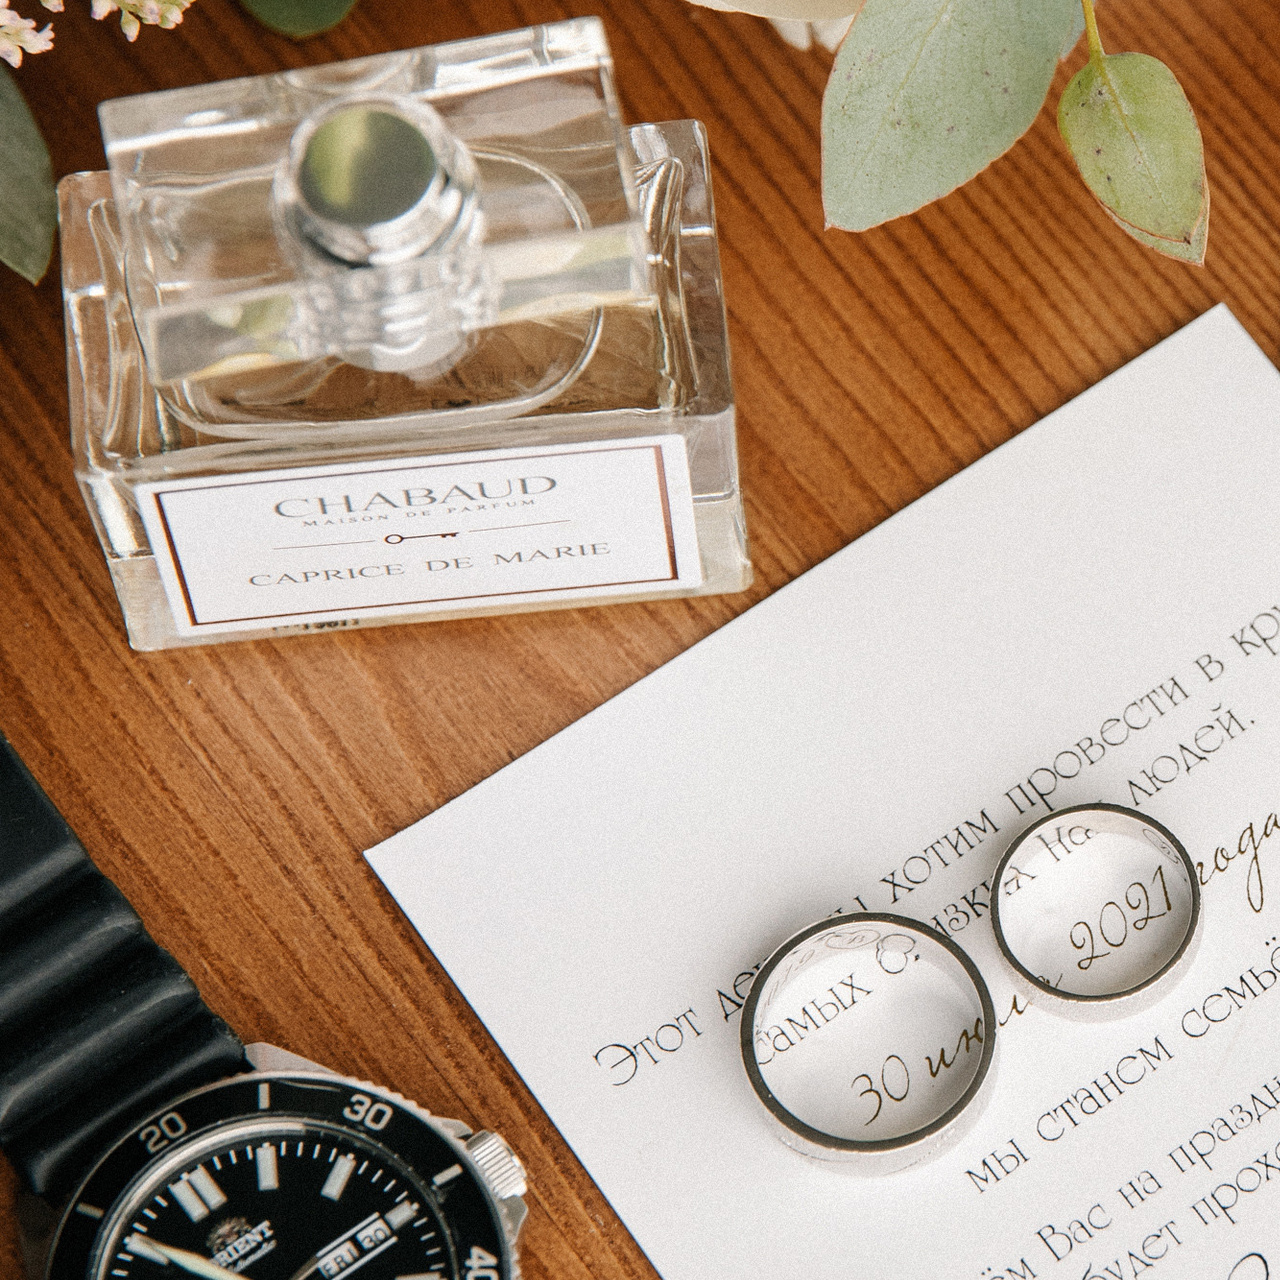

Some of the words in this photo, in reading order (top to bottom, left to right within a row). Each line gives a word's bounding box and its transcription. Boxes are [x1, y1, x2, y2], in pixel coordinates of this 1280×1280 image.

[274, 475, 558, 519] CHABAUD
[302, 513, 390, 528] MAISON
[405, 509, 431, 519] DE
[249, 563, 406, 588] CAPRICE
[427, 556, 475, 573] DE
[494, 542, 613, 566] MARIE
[1126, 702, 1256, 807] людей.
[593, 1007, 704, 1087] Этот
[879, 807, 1001, 905] хотим
[1003, 676, 1191, 814] провести
[1193, 653, 1226, 683] в
[850, 1054, 911, 1127] 30
[1069, 864, 1172, 970] 2021
[138, 1111, 188, 1154] 20
[342, 1093, 394, 1132] 30
[964, 1138, 1031, 1194] мы
[1035, 1034, 1175, 1143] станем
[1035, 1202, 1114, 1262] Вас
[1115, 1169, 1164, 1210] на
[212, 1220, 275, 1268] RIENT
[322, 1244, 359, 1278] FRI
[361, 1226, 390, 1250] 30
